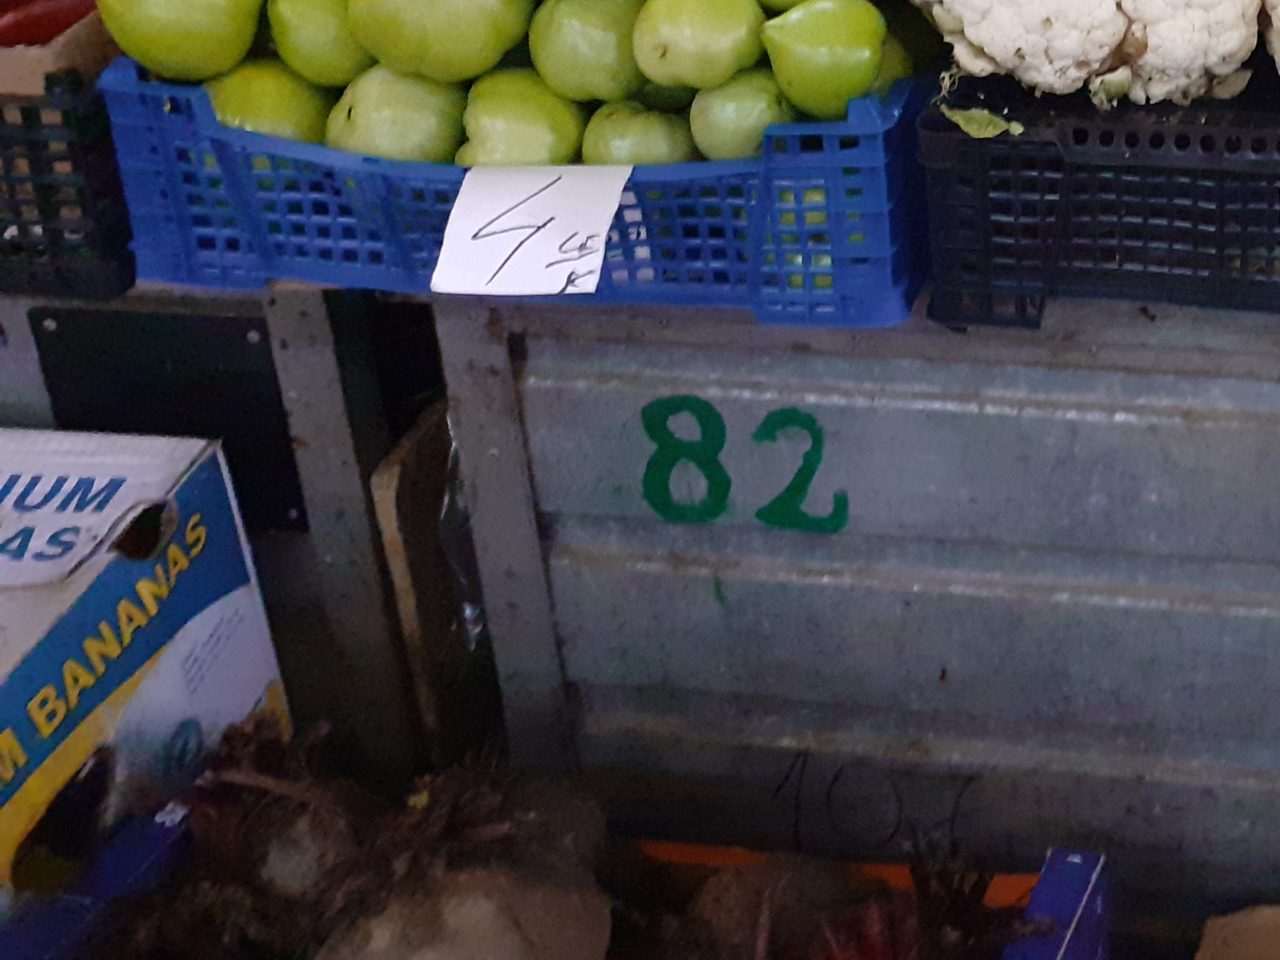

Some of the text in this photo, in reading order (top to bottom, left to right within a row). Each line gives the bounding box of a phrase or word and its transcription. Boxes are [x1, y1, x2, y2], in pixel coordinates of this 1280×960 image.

[471, 174, 562, 286] 4
[641, 394, 849, 534] 82
[27, 513, 207, 738] BANANAS
